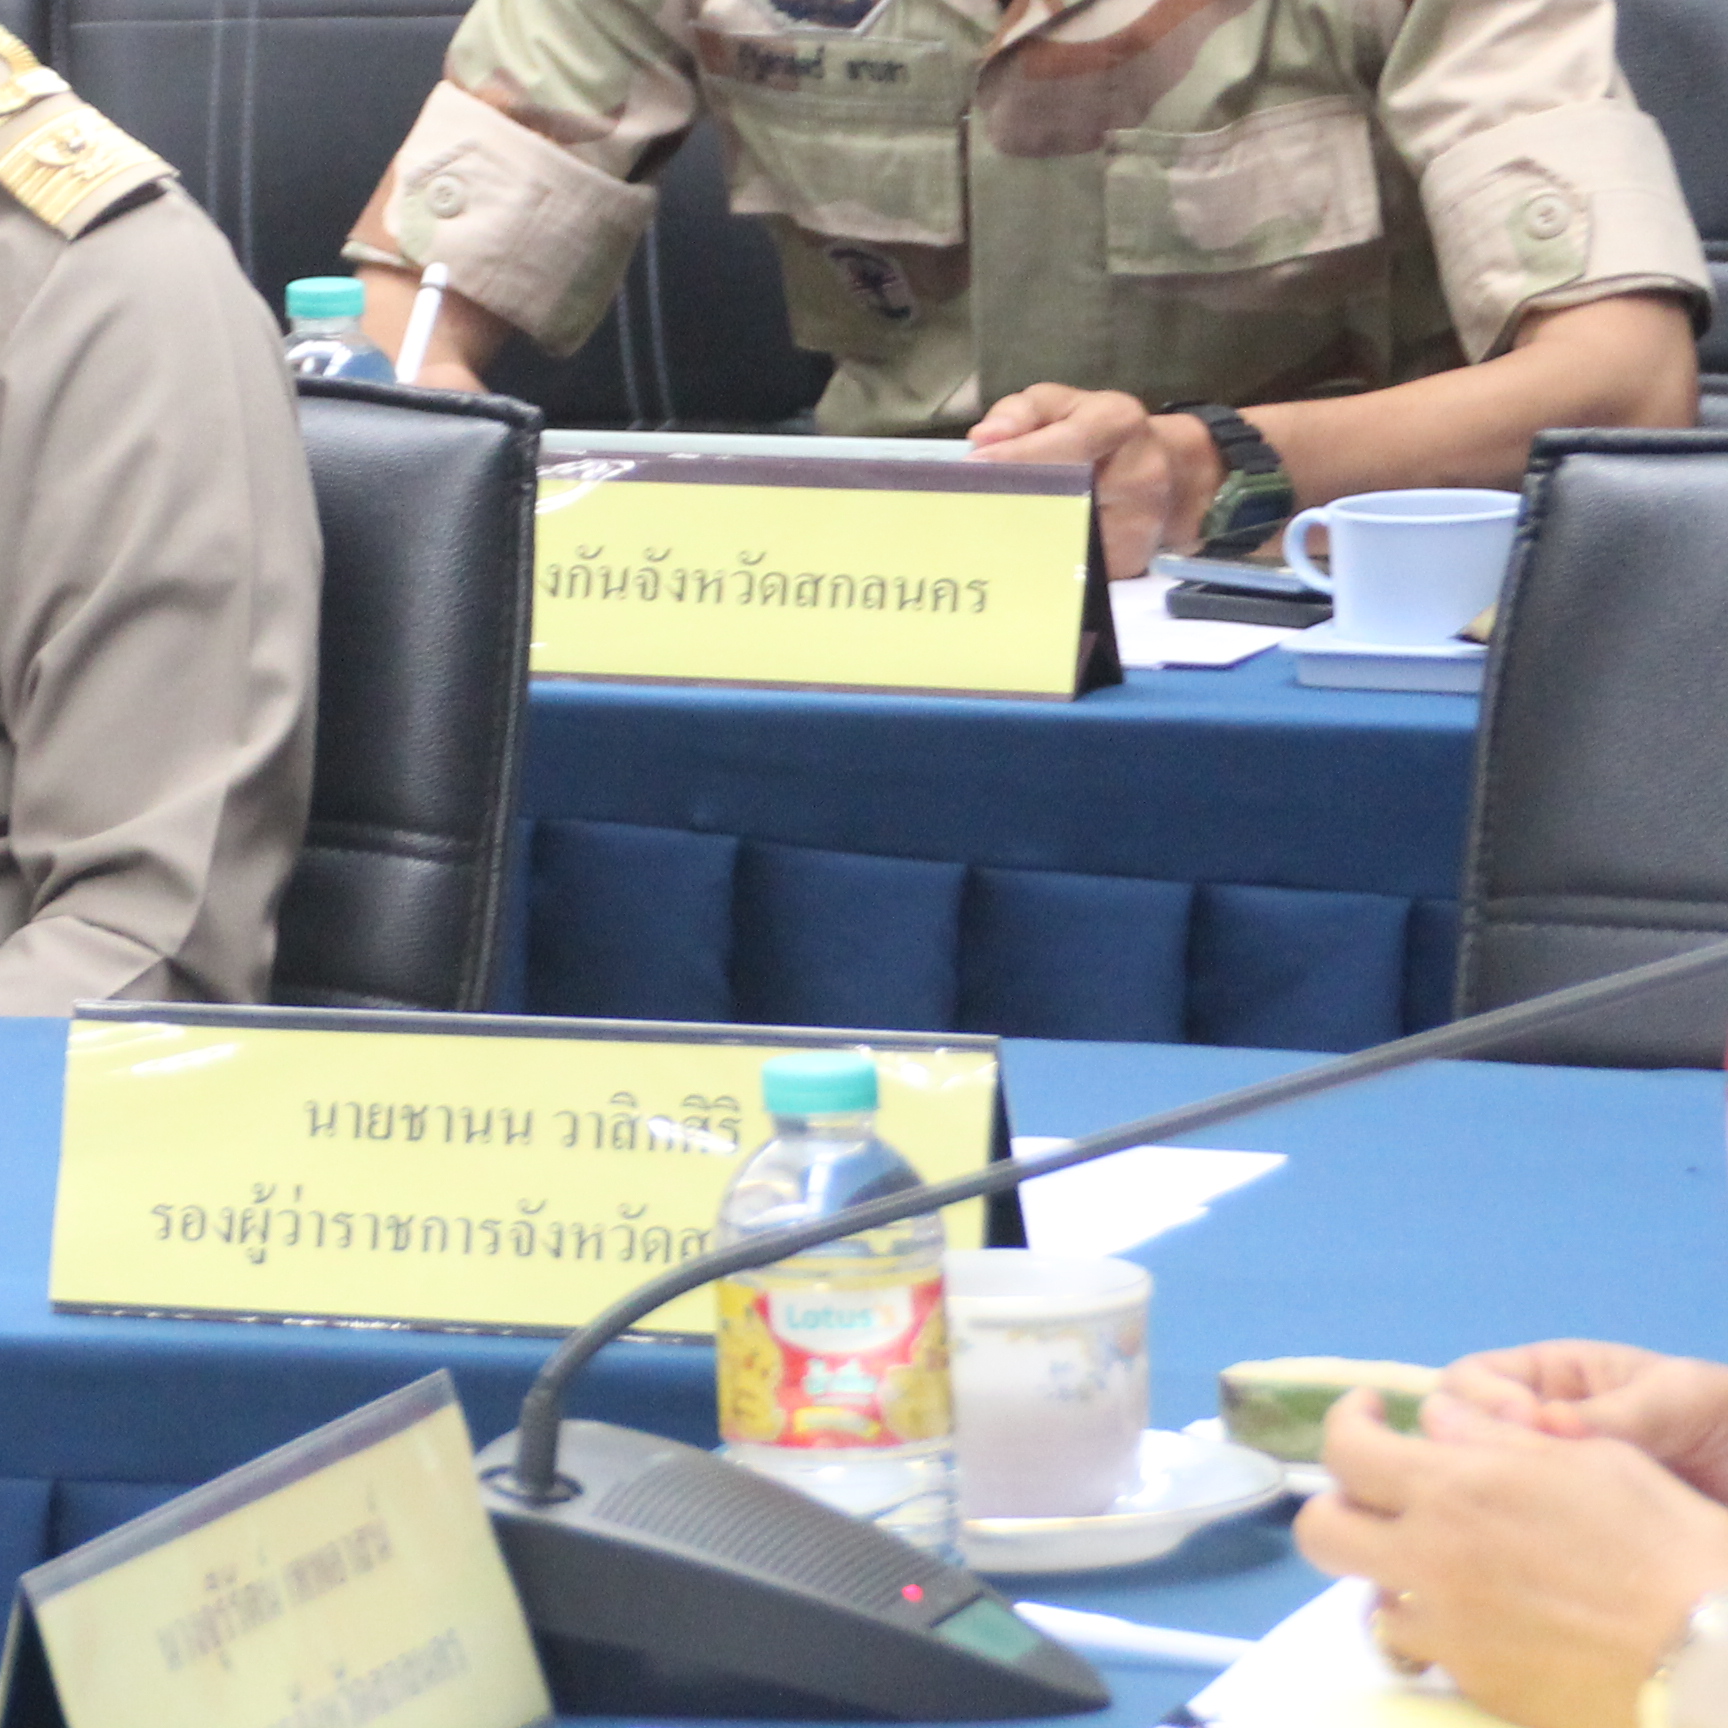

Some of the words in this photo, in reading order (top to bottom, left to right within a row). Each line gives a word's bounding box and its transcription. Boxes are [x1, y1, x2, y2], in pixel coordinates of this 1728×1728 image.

[540, 544, 990, 613] งกันจังหวัดสกลนคร
[304, 1097, 533, 1145] นายชานน
[149, 1182, 712, 1266] รองผู้ว่าราชการจังหวัดส
